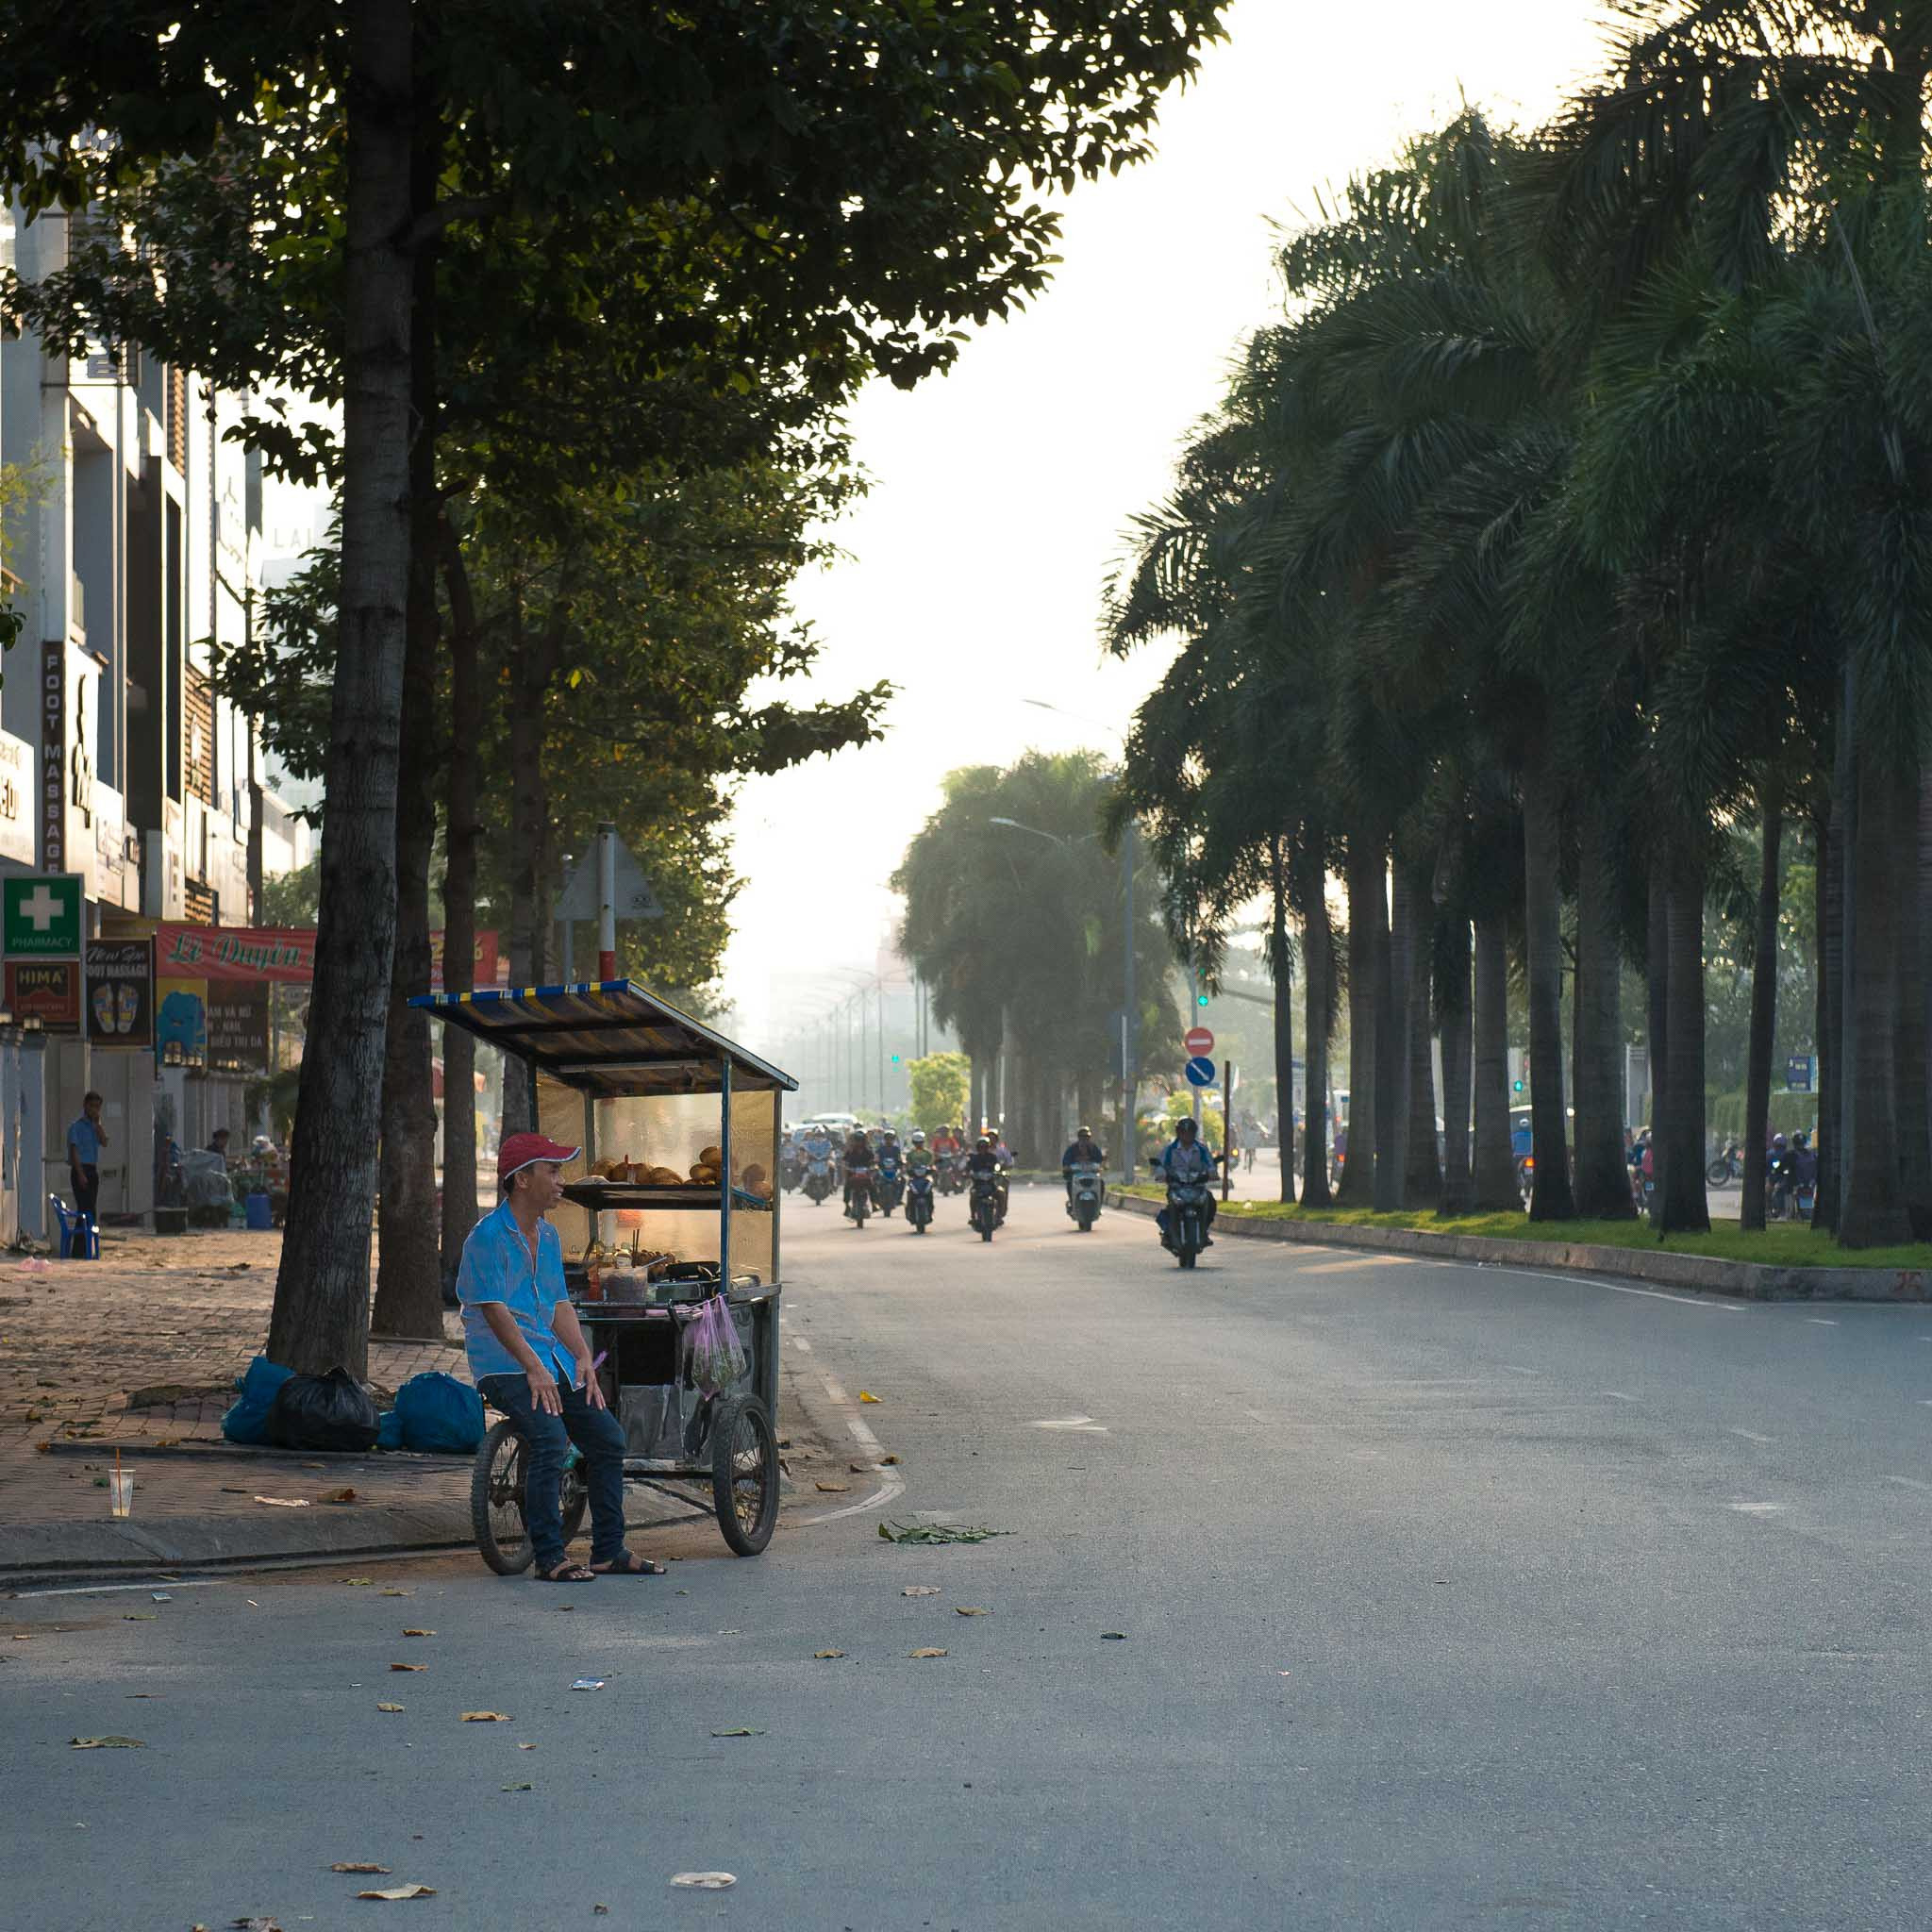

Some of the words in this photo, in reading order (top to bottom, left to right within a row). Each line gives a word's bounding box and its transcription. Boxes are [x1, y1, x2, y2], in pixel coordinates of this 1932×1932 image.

[47, 656, 58, 730] FOOT
[44, 744, 61, 874] MASSAGE
[12, 936, 73, 949] PHARMACY
[88, 946, 119, 962] New
[19, 970, 62, 984] HIMA
[106, 964, 148, 977] MASSAGE
